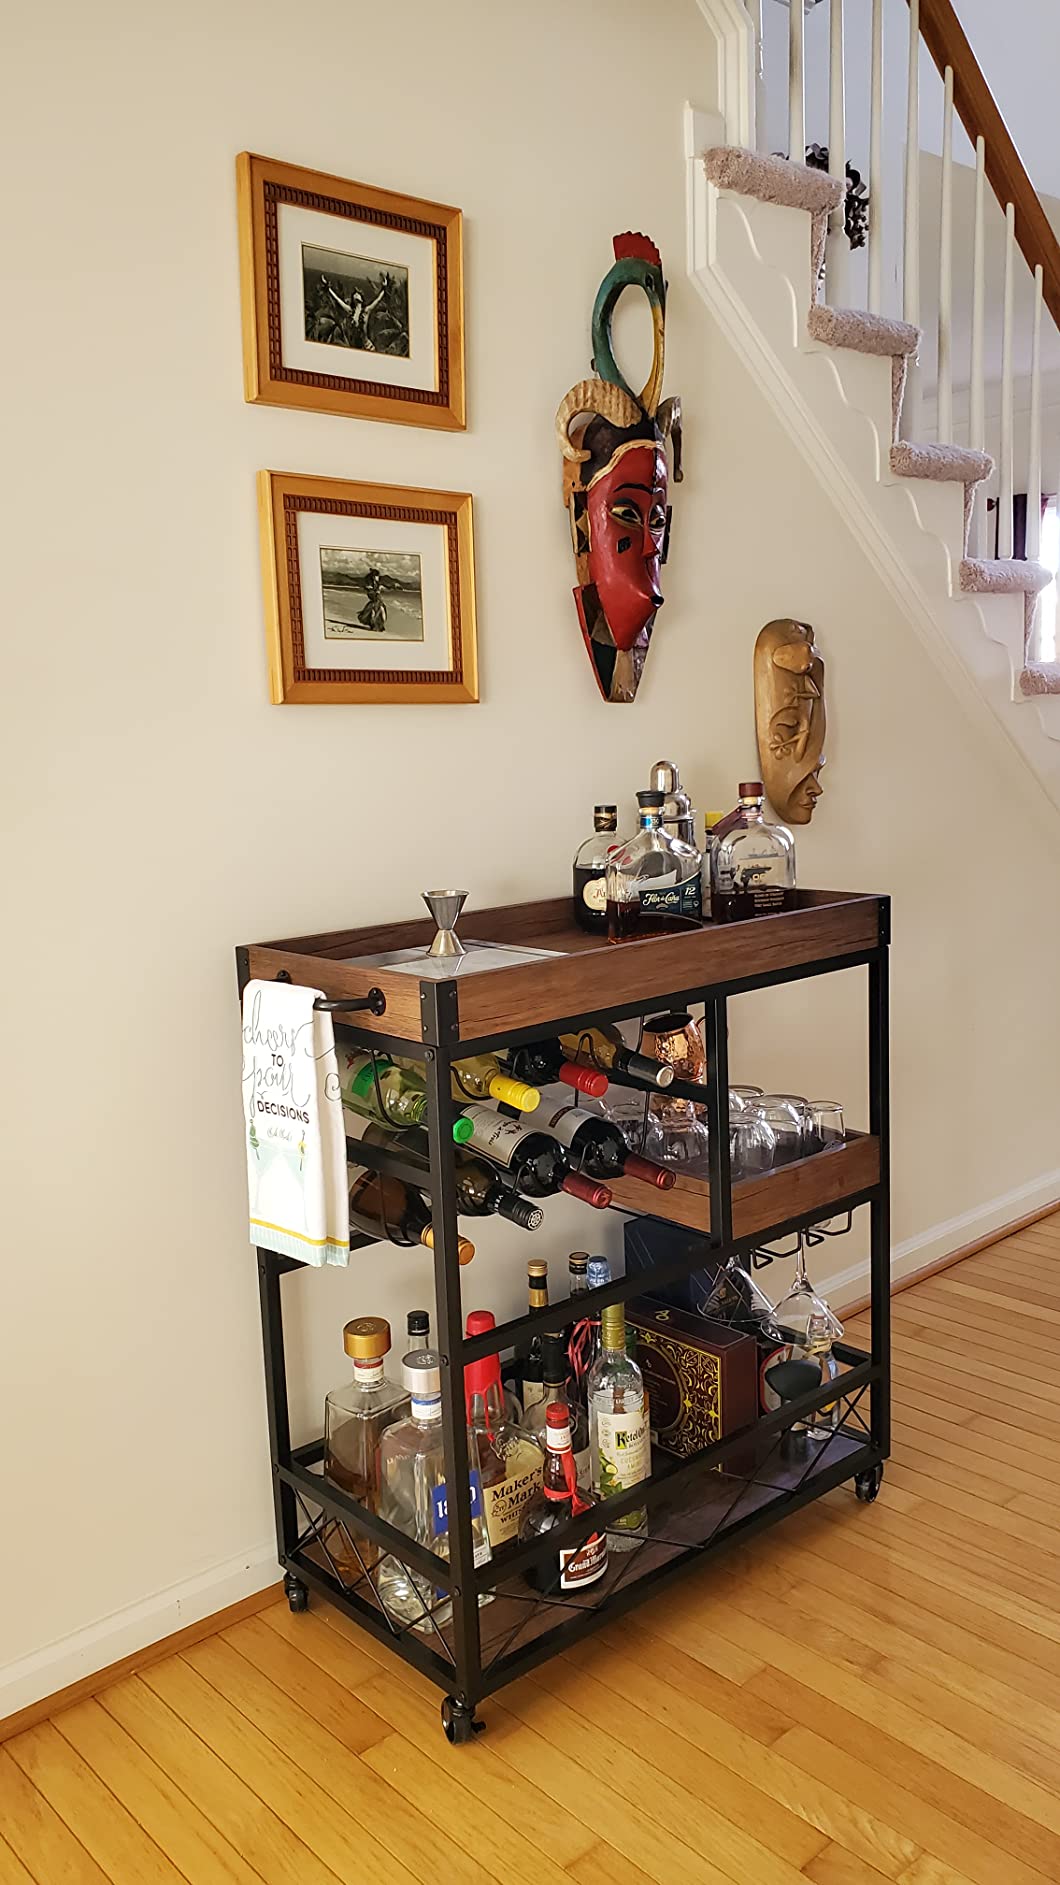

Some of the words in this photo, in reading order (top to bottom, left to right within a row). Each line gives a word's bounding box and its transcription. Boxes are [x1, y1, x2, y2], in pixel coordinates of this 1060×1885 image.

[684, 886, 696, 896] 12
[271, 1053, 284, 1067] TO
[257, 1100, 310, 1124] DECISIONS
[491, 1466, 542, 1502] Maker's
[507, 1481, 541, 1510] Mark
